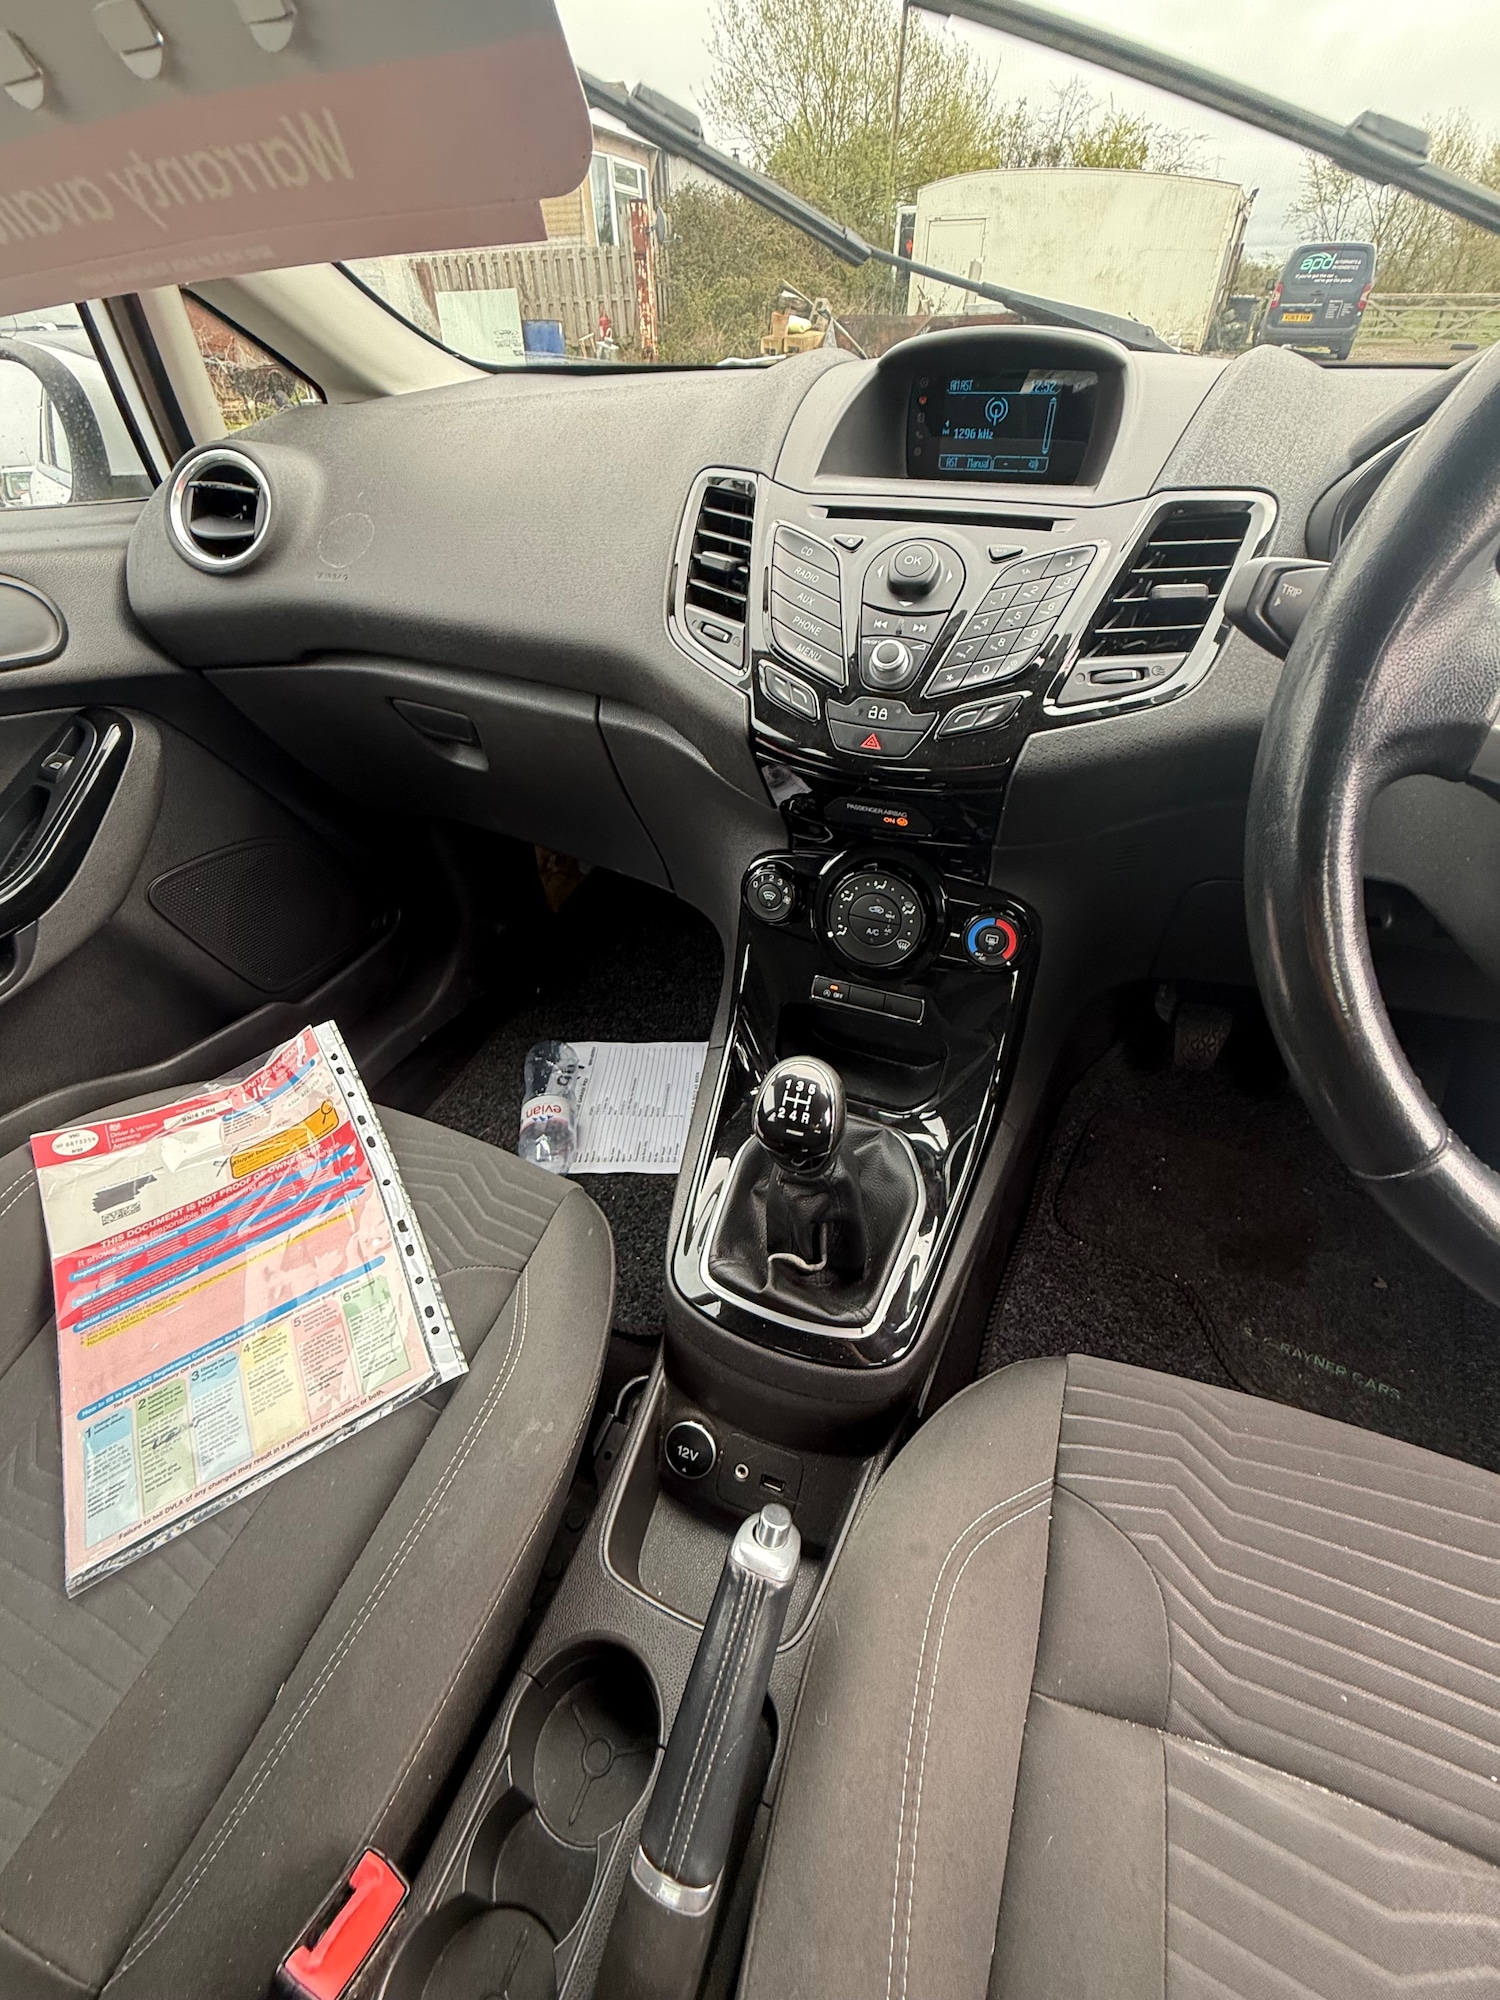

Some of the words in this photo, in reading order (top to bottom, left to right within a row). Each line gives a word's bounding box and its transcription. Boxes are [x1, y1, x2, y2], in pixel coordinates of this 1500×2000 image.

[1300, 251, 1337, 274] apd
[953, 429, 976, 439] 1296
[978, 429, 993, 440] kHz
[967, 457, 990, 470] Manual
[800, 546, 814, 557] CD
[904, 556, 922, 566] OK
[794, 566, 820, 584] RADIO
[1063, 577, 1072, 586] 3
[1030, 586, 1039, 594] 2
[1282, 583, 1303, 598] TRIP
[796, 592, 816, 606] AUX
[1001, 593, 1006, 601] 1
[1047, 601, 1055, 611] 6
[981, 617, 989, 627] 4
[1014, 611, 1022, 621] 5
[792, 615, 822, 636] PHONE
[1032, 629, 1040, 639] 9
[997, 638, 1006, 648] 8
[795, 643, 821, 662] MENU
[965, 645, 974, 654] 7
[982, 664, 990, 674] 0
[846, 803, 882, 814] PASSENGER
[883, 808, 908, 818] AIRBAG
[883, 816, 896, 824] ON
[777, 878, 783, 886] 3
[866, 928, 880, 936] A/C
[239, 1071, 272, 1092] UNITED
[785, 1079, 793, 1090] 1
[795, 1080, 805, 1092] 3
[241, 1082, 273, 1104] UK
[808, 1083, 817, 1095] 5
[526, 1104, 562, 1118] evian
[777, 1107, 787, 1119] 2
[789, 1110, 798, 1122] 4
[801, 1111, 811, 1125] R
[109, 1130, 129, 1138] Driver
[77, 1258, 85, 1266] It
[86, 1246, 117, 1263] shows
[118, 1237, 137, 1250] who
[148, 1209, 198, 1237] responsible
[199, 1203, 213, 1213] for
[258, 1173, 274, 1187] and
[300, 1156, 314, 1166] the
[101, 1233, 125, 1248] THIS
[126, 1207, 184, 1237] DOCUMENT
[185, 1202, 196, 1211] IS
[196, 1192, 218, 1206] NOT
[218, 1175, 252, 1196] PROOF
[252, 1169, 266, 1180] OF
[342, 1291, 351, 1302] 6
[76, 1313, 100, 1329] Special
[101, 1306, 119, 1317] notes
[291, 1315, 302, 1327] 5
[241, 1342, 250, 1353] 4
[190, 1370, 200, 1381] 3
[81, 1404, 97, 1415] How
[152, 1355, 191, 1378] Registration
[1352, 1372, 1401, 1400] CARS
[135, 1398, 147, 1410] 2
[84, 1427, 92, 1438] 1
[678, 1445, 699, 1461] 12V
[117, 1520, 141, 1539] Failure
[142, 1516, 151, 1524] to
[151, 1506, 162, 1519] tell
[163, 1495, 184, 1514] DVLA
[184, 1491, 193, 1501] of
[193, 1485, 207, 1496] any
[207, 1469, 236, 1489] changes
[237, 1461, 253, 1472] may
[253, 1447, 272, 1464] result
[286, 1427, 311, 1448] penalty
[311, 1423, 318, 1431] or
[319, 1403, 359, 1428] prosecution,
[366, 1386, 384, 1399] both.
